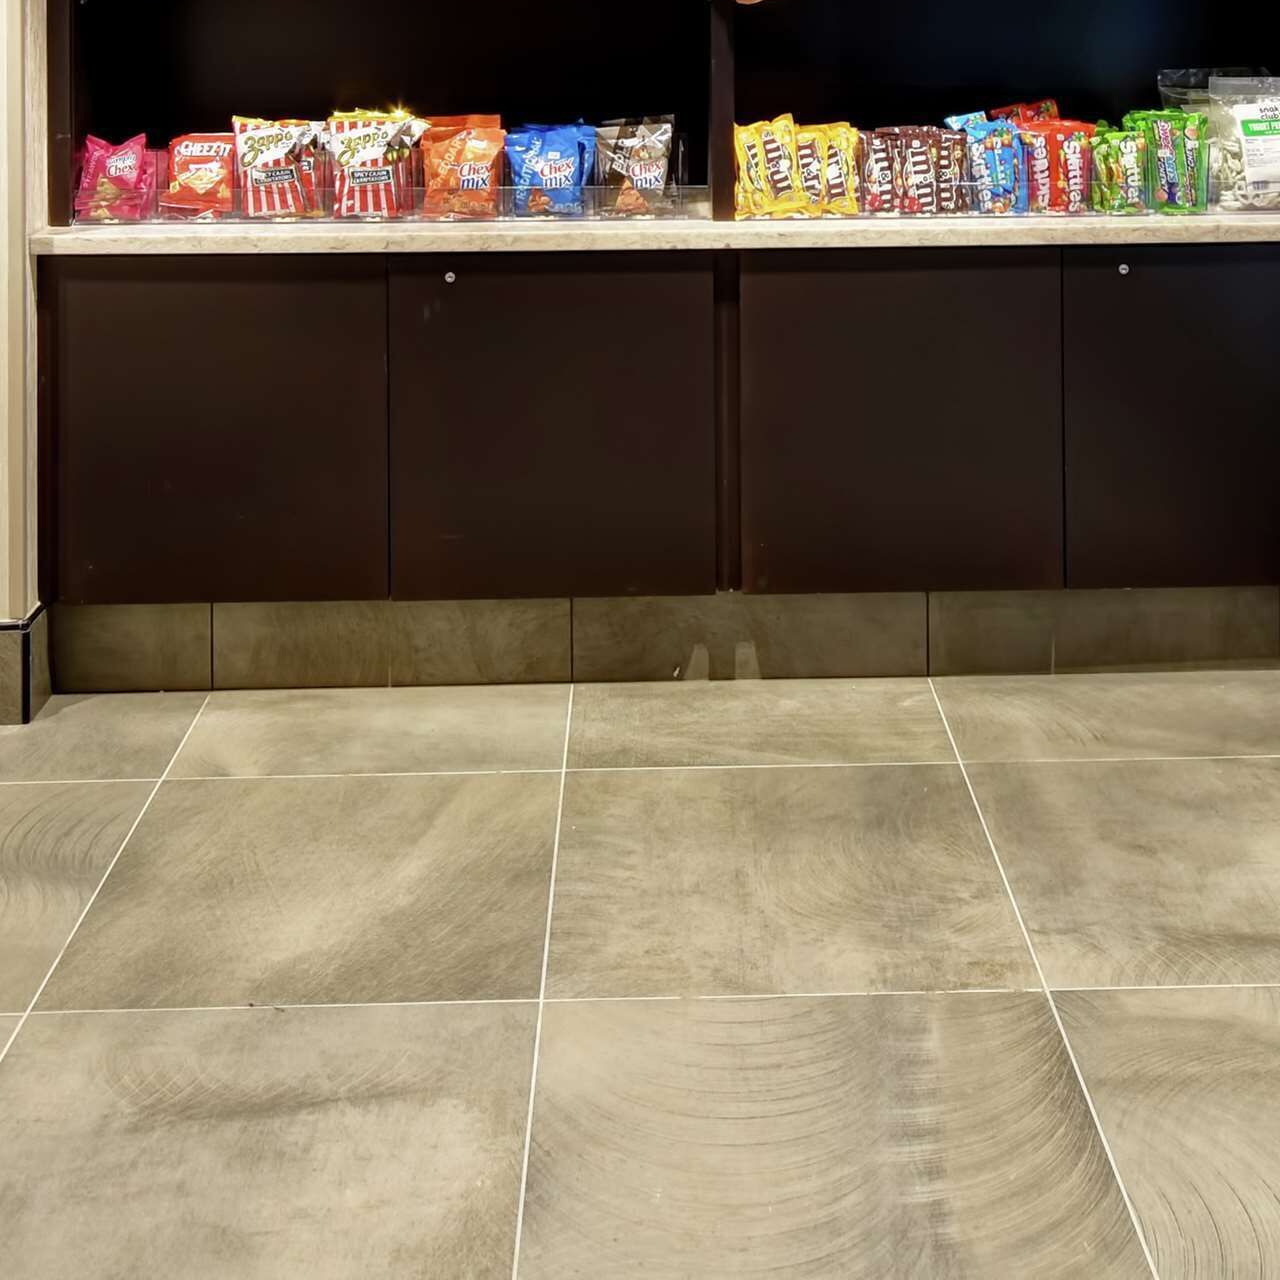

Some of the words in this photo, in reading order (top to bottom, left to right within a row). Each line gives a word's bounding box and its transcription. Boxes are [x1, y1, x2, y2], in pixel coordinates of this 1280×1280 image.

[1260, 112, 1279, 120] club
[107, 164, 136, 175] Chex
[459, 163, 492, 178] Chex
[540, 161, 573, 176] Chex
[630, 162, 663, 177] Chex
[461, 175, 489, 189] mix
[544, 175, 572, 188] mix
[634, 175, 662, 188] mix
